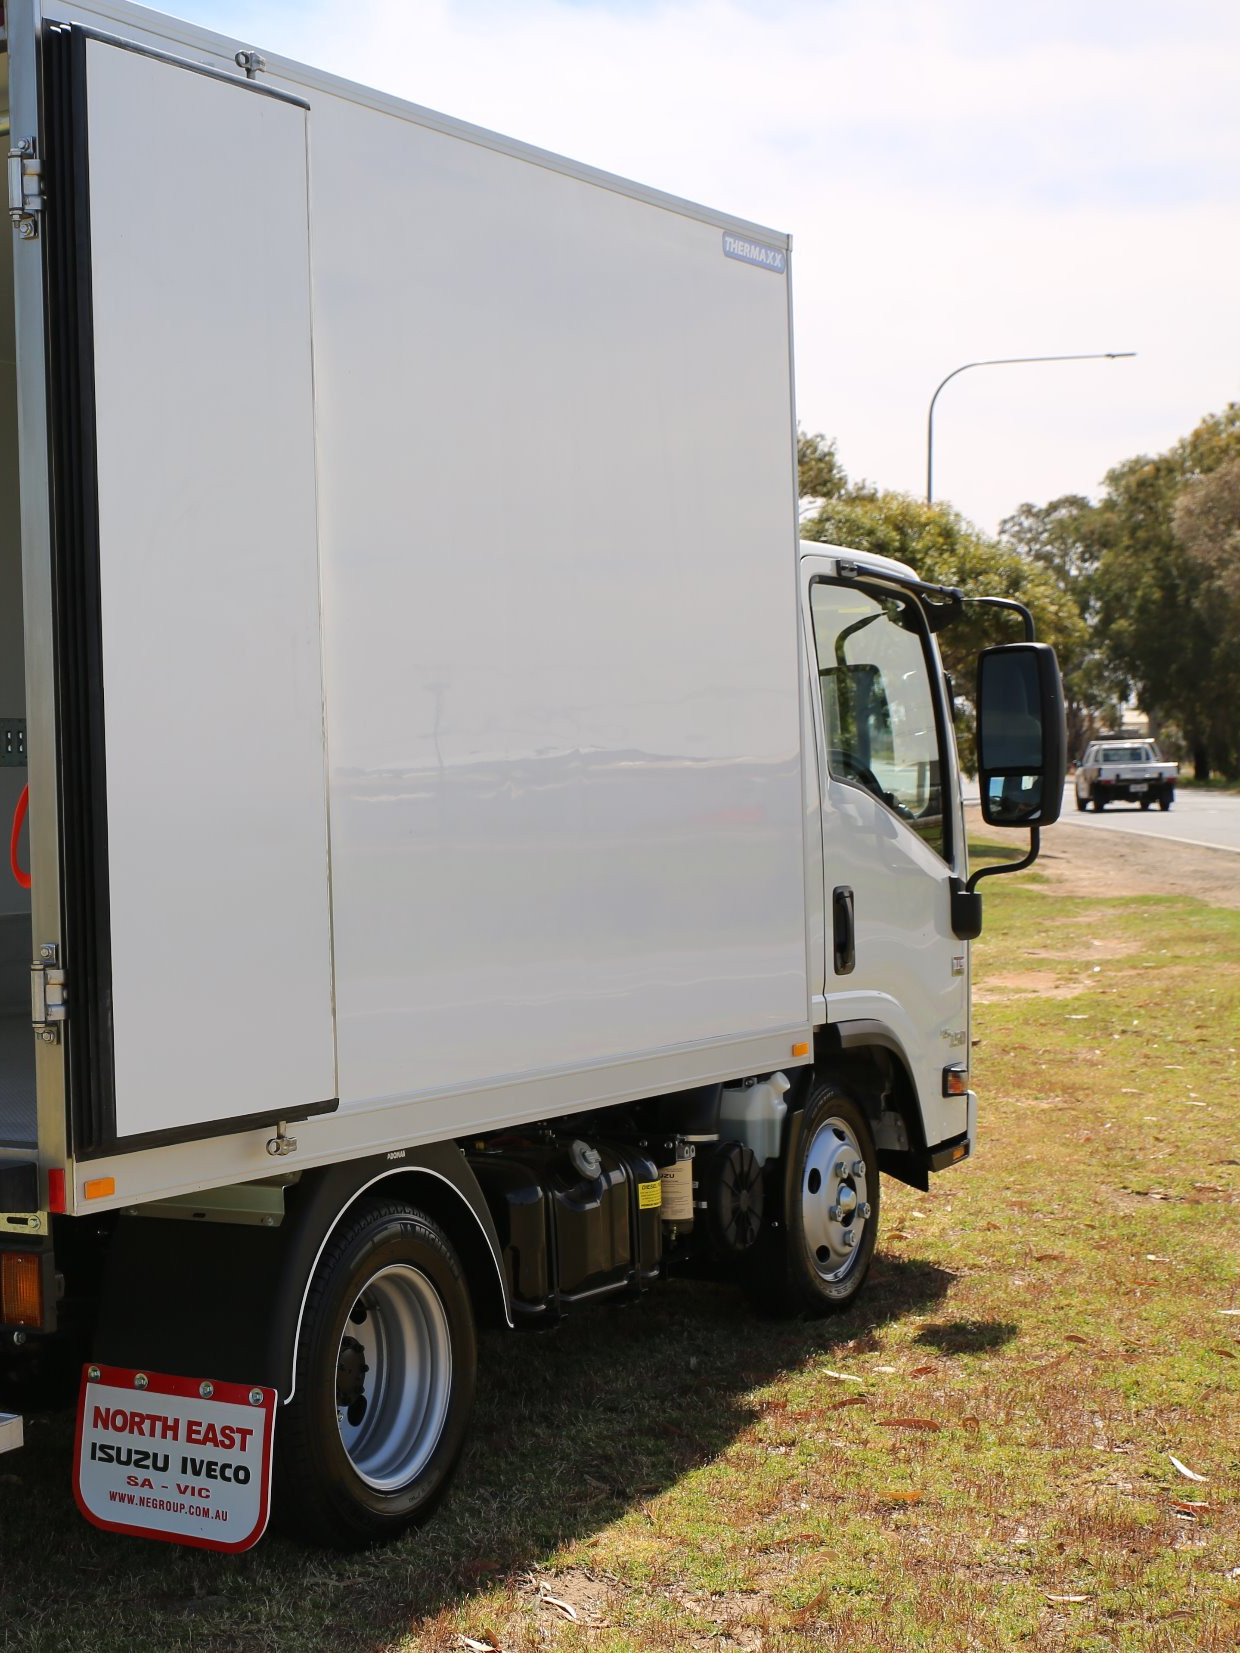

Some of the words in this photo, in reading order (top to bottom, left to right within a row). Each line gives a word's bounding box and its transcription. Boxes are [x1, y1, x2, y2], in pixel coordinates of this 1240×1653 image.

[725, 236, 783, 269] THERMAXX
[92, 1405, 180, 1442] NORTH
[186, 1419, 254, 1452] EAST
[90, 1442, 170, 1473] ISUZU
[181, 1456, 251, 1485] IVECO
[126, 1475, 154, 1490] SA
[176, 1483, 211, 1499] VIC
[109, 1490, 228, 1522] WWW.NEGROUP.COM.AU
